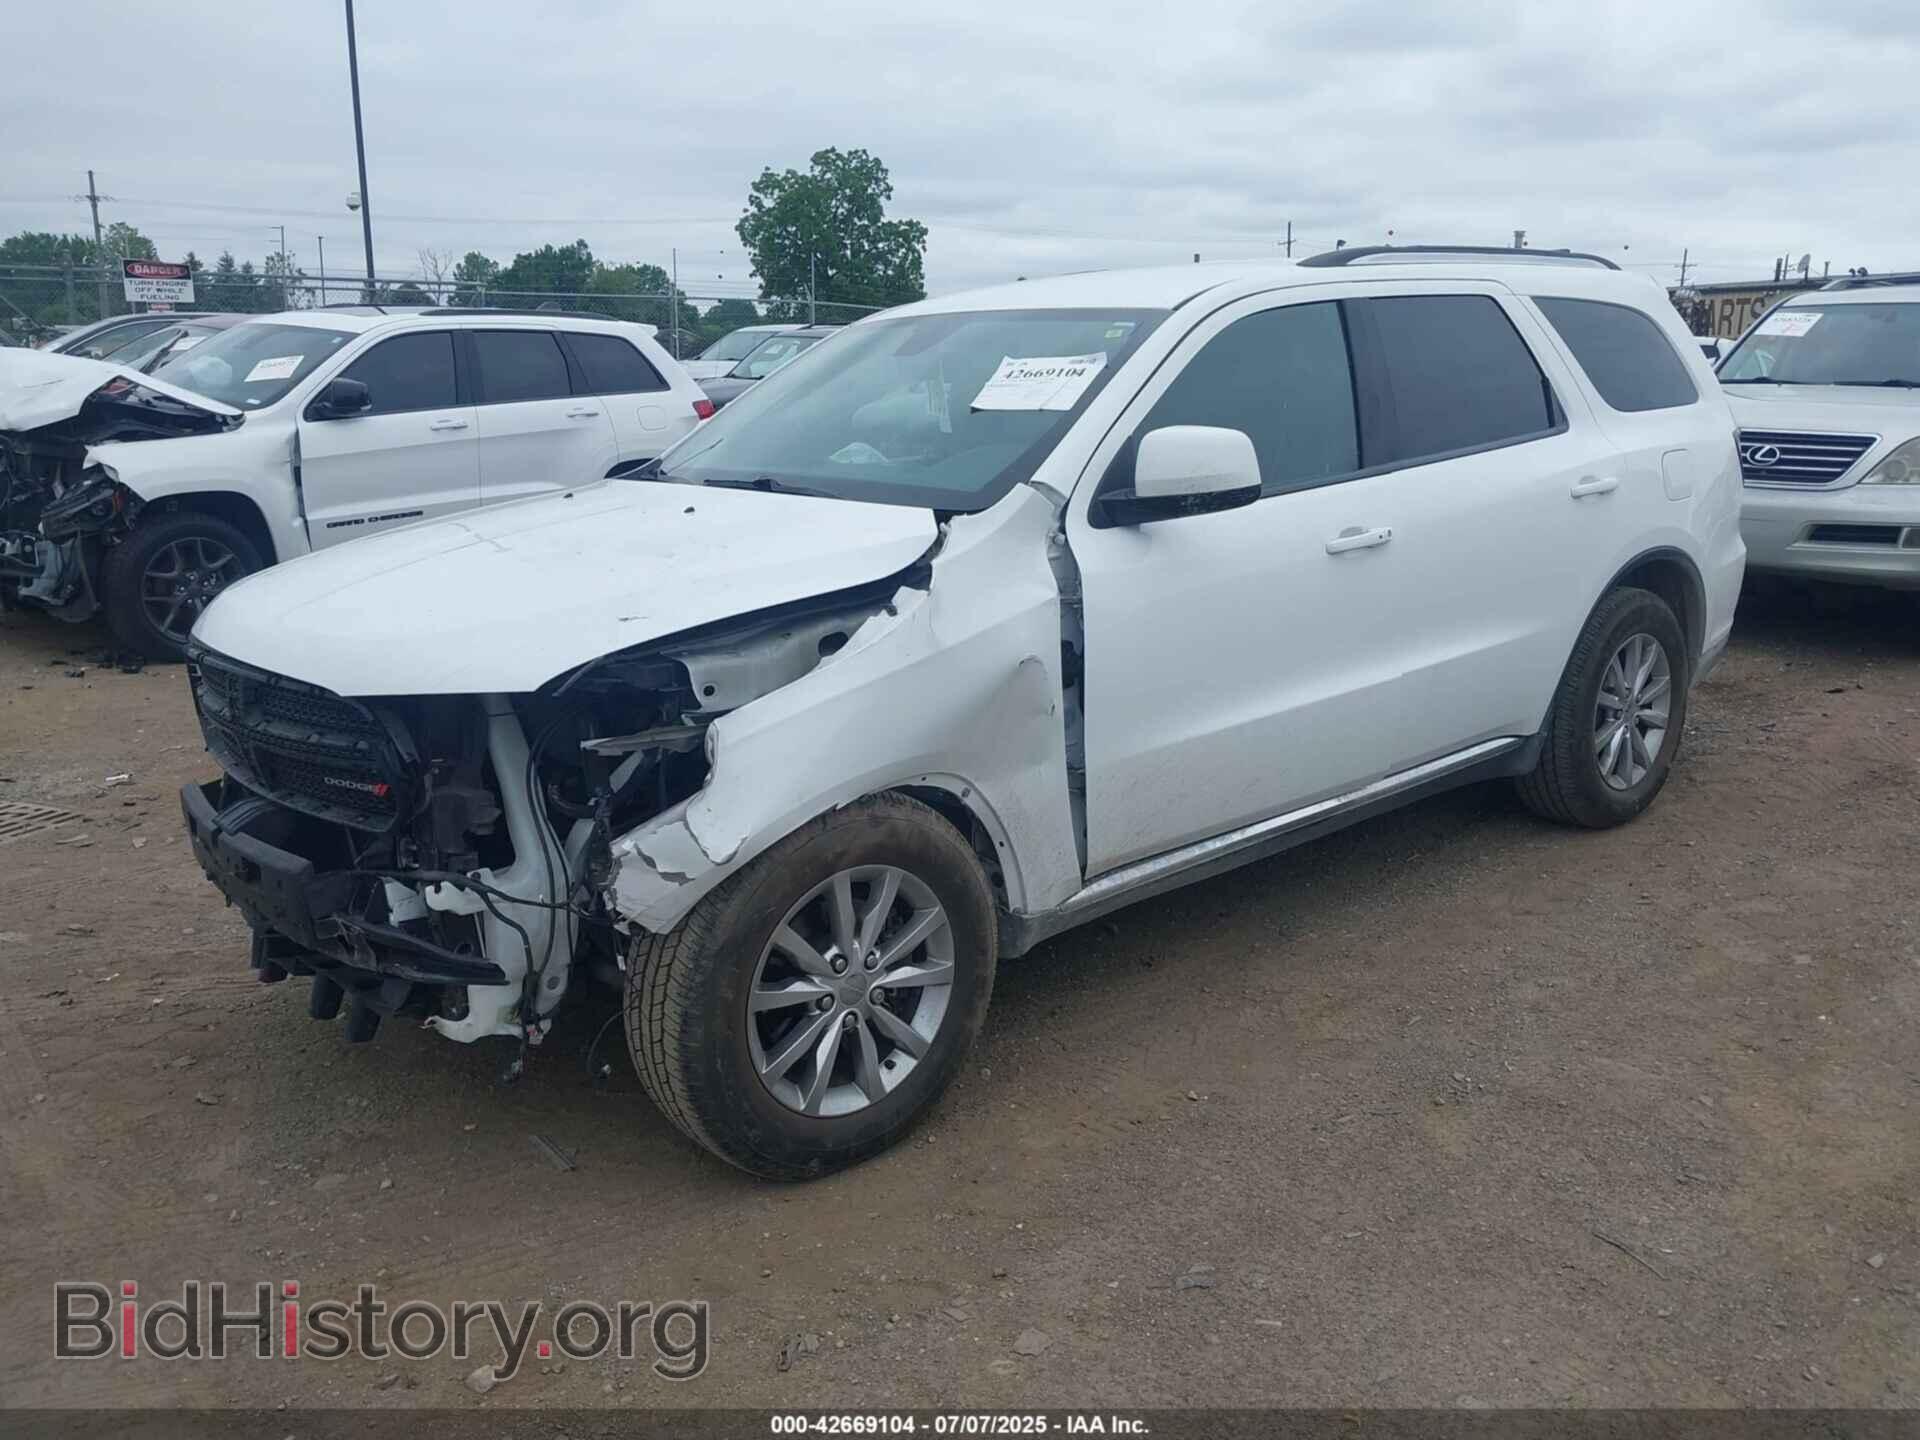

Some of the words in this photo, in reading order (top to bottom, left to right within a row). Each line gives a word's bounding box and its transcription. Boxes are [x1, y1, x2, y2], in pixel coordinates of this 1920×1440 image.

[133, 264, 178, 275] DANGER
[1694, 297, 1765, 335] ARTS
[326, 518, 365, 528] GRAND
[368, 510, 424, 523] CHEROKEE
[324, 776, 375, 793] DODGE
